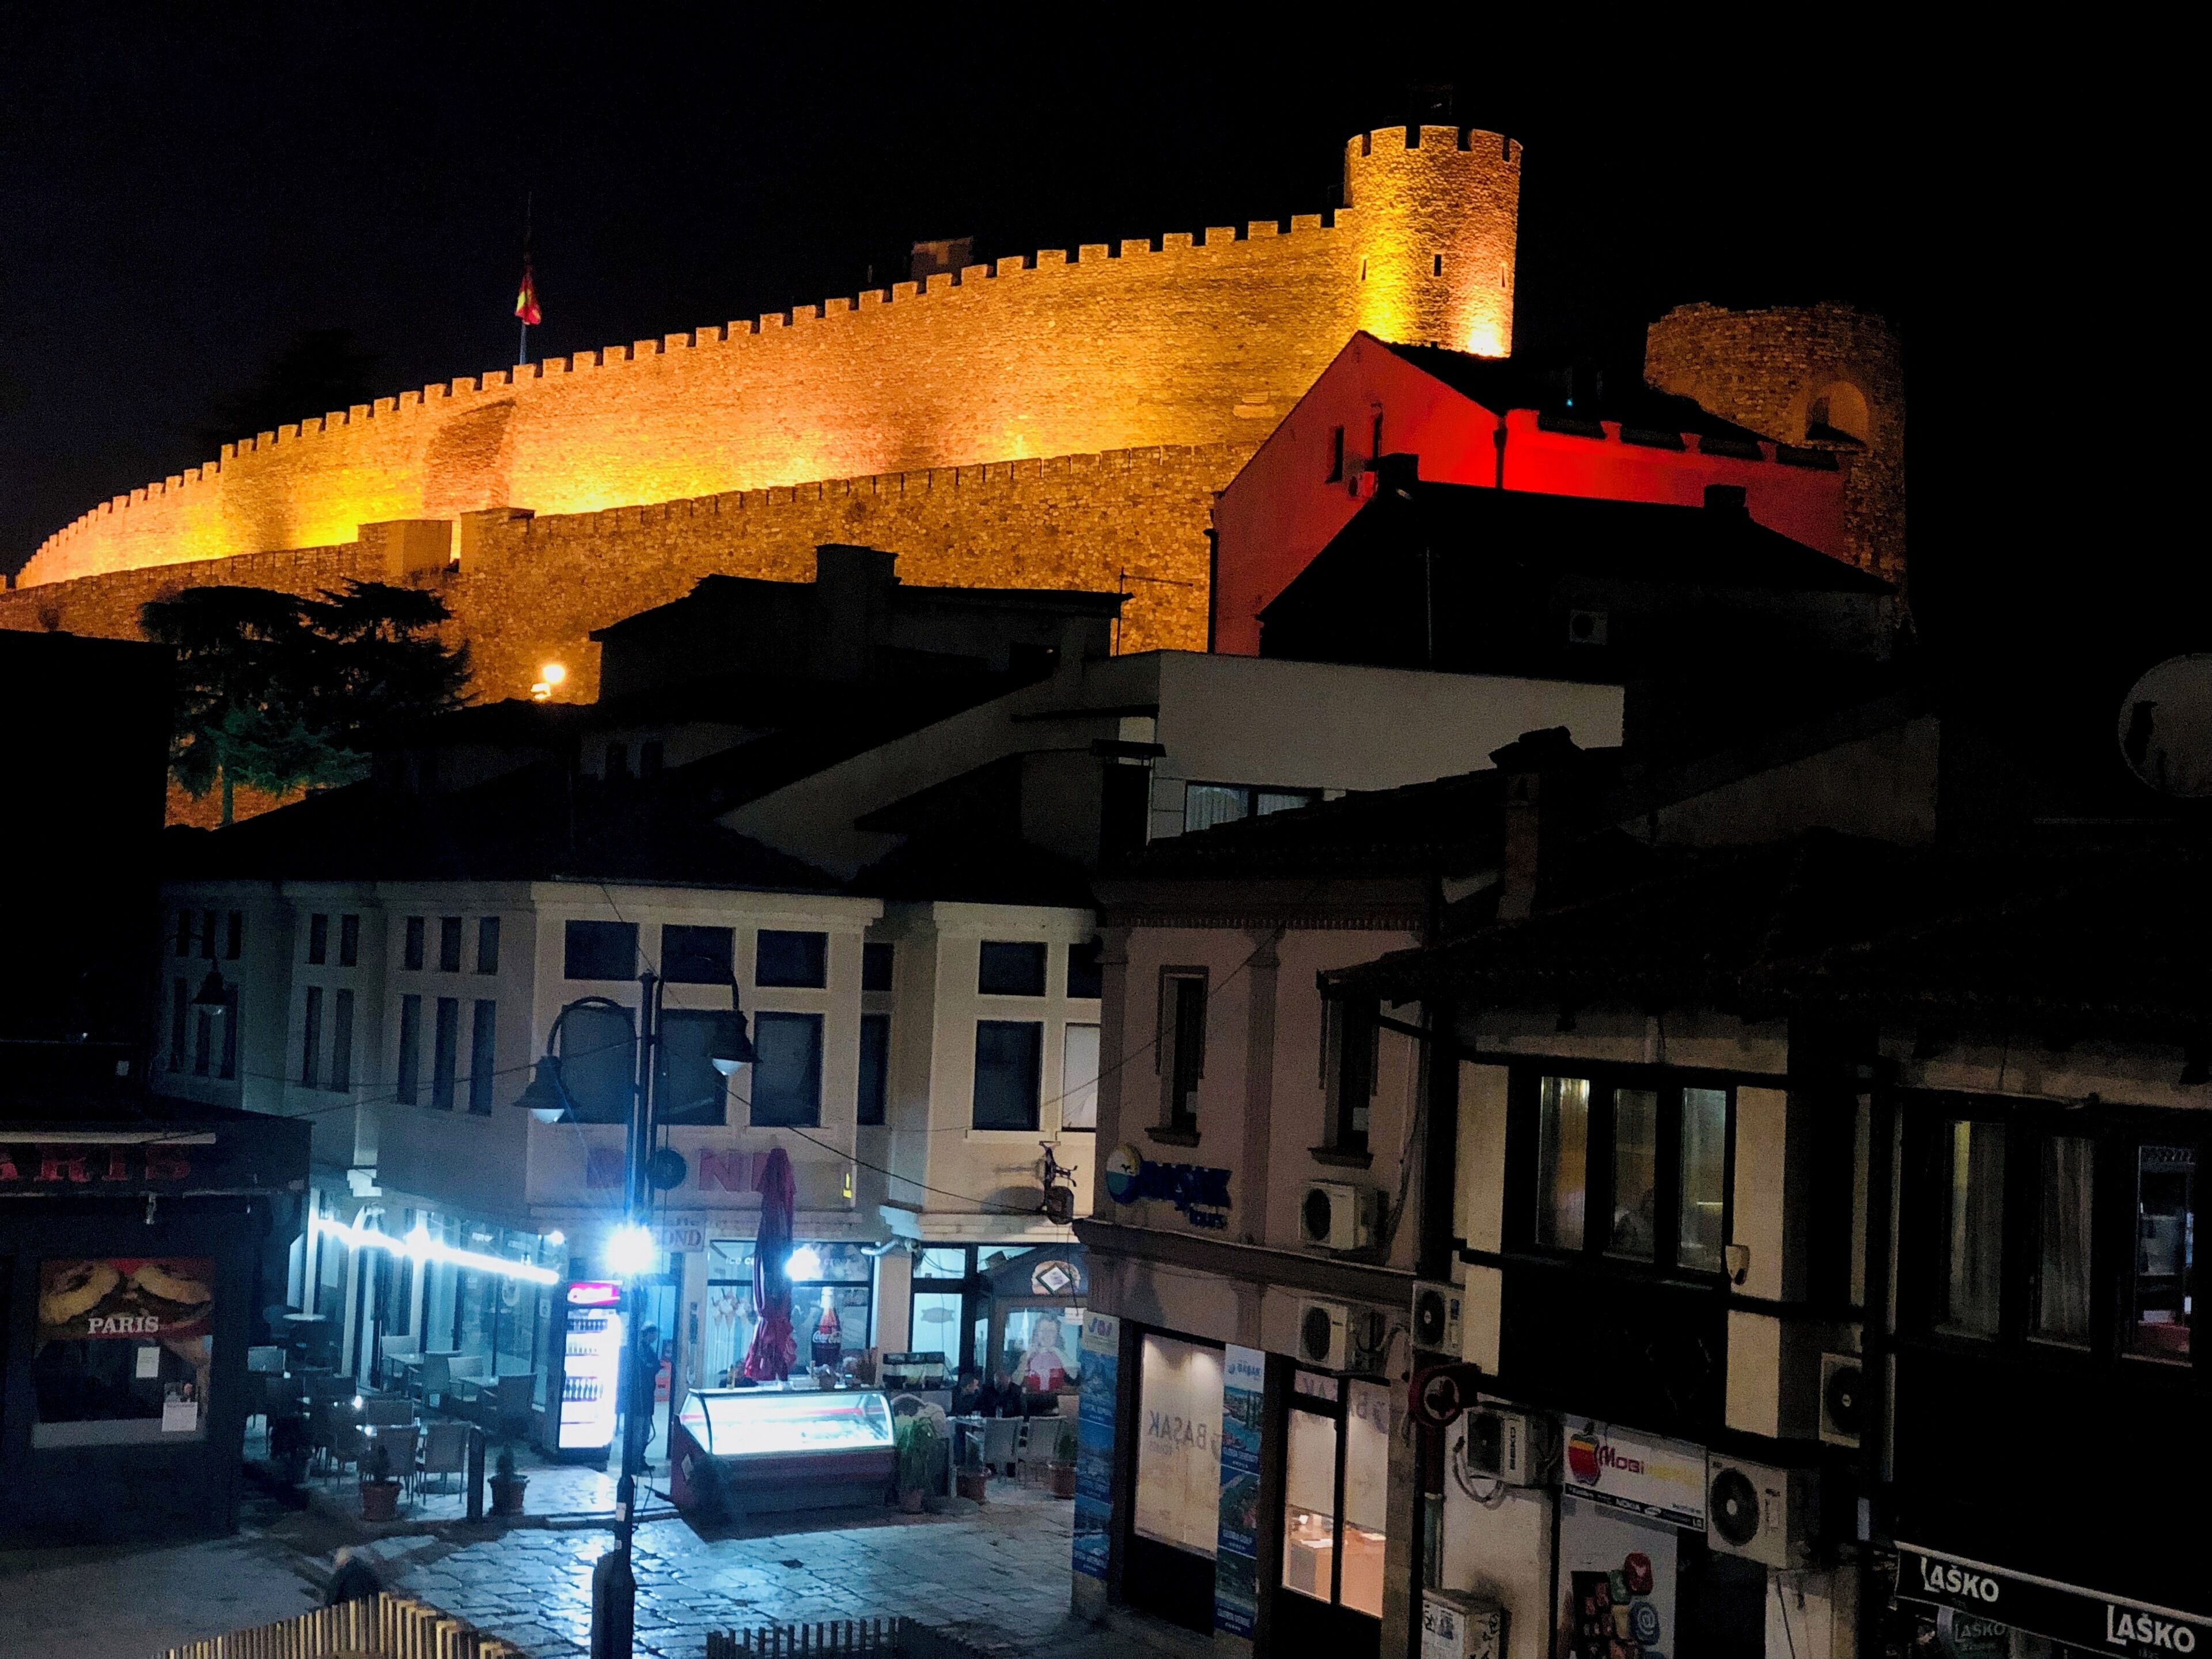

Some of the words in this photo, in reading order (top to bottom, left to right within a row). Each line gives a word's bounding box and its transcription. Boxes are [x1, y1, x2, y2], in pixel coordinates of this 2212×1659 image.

[87, 1315, 160, 1335] PARIS
[1919, 1556, 2001, 1604] LAŠKO
[2105, 1604, 2198, 1655] LAŠKO
